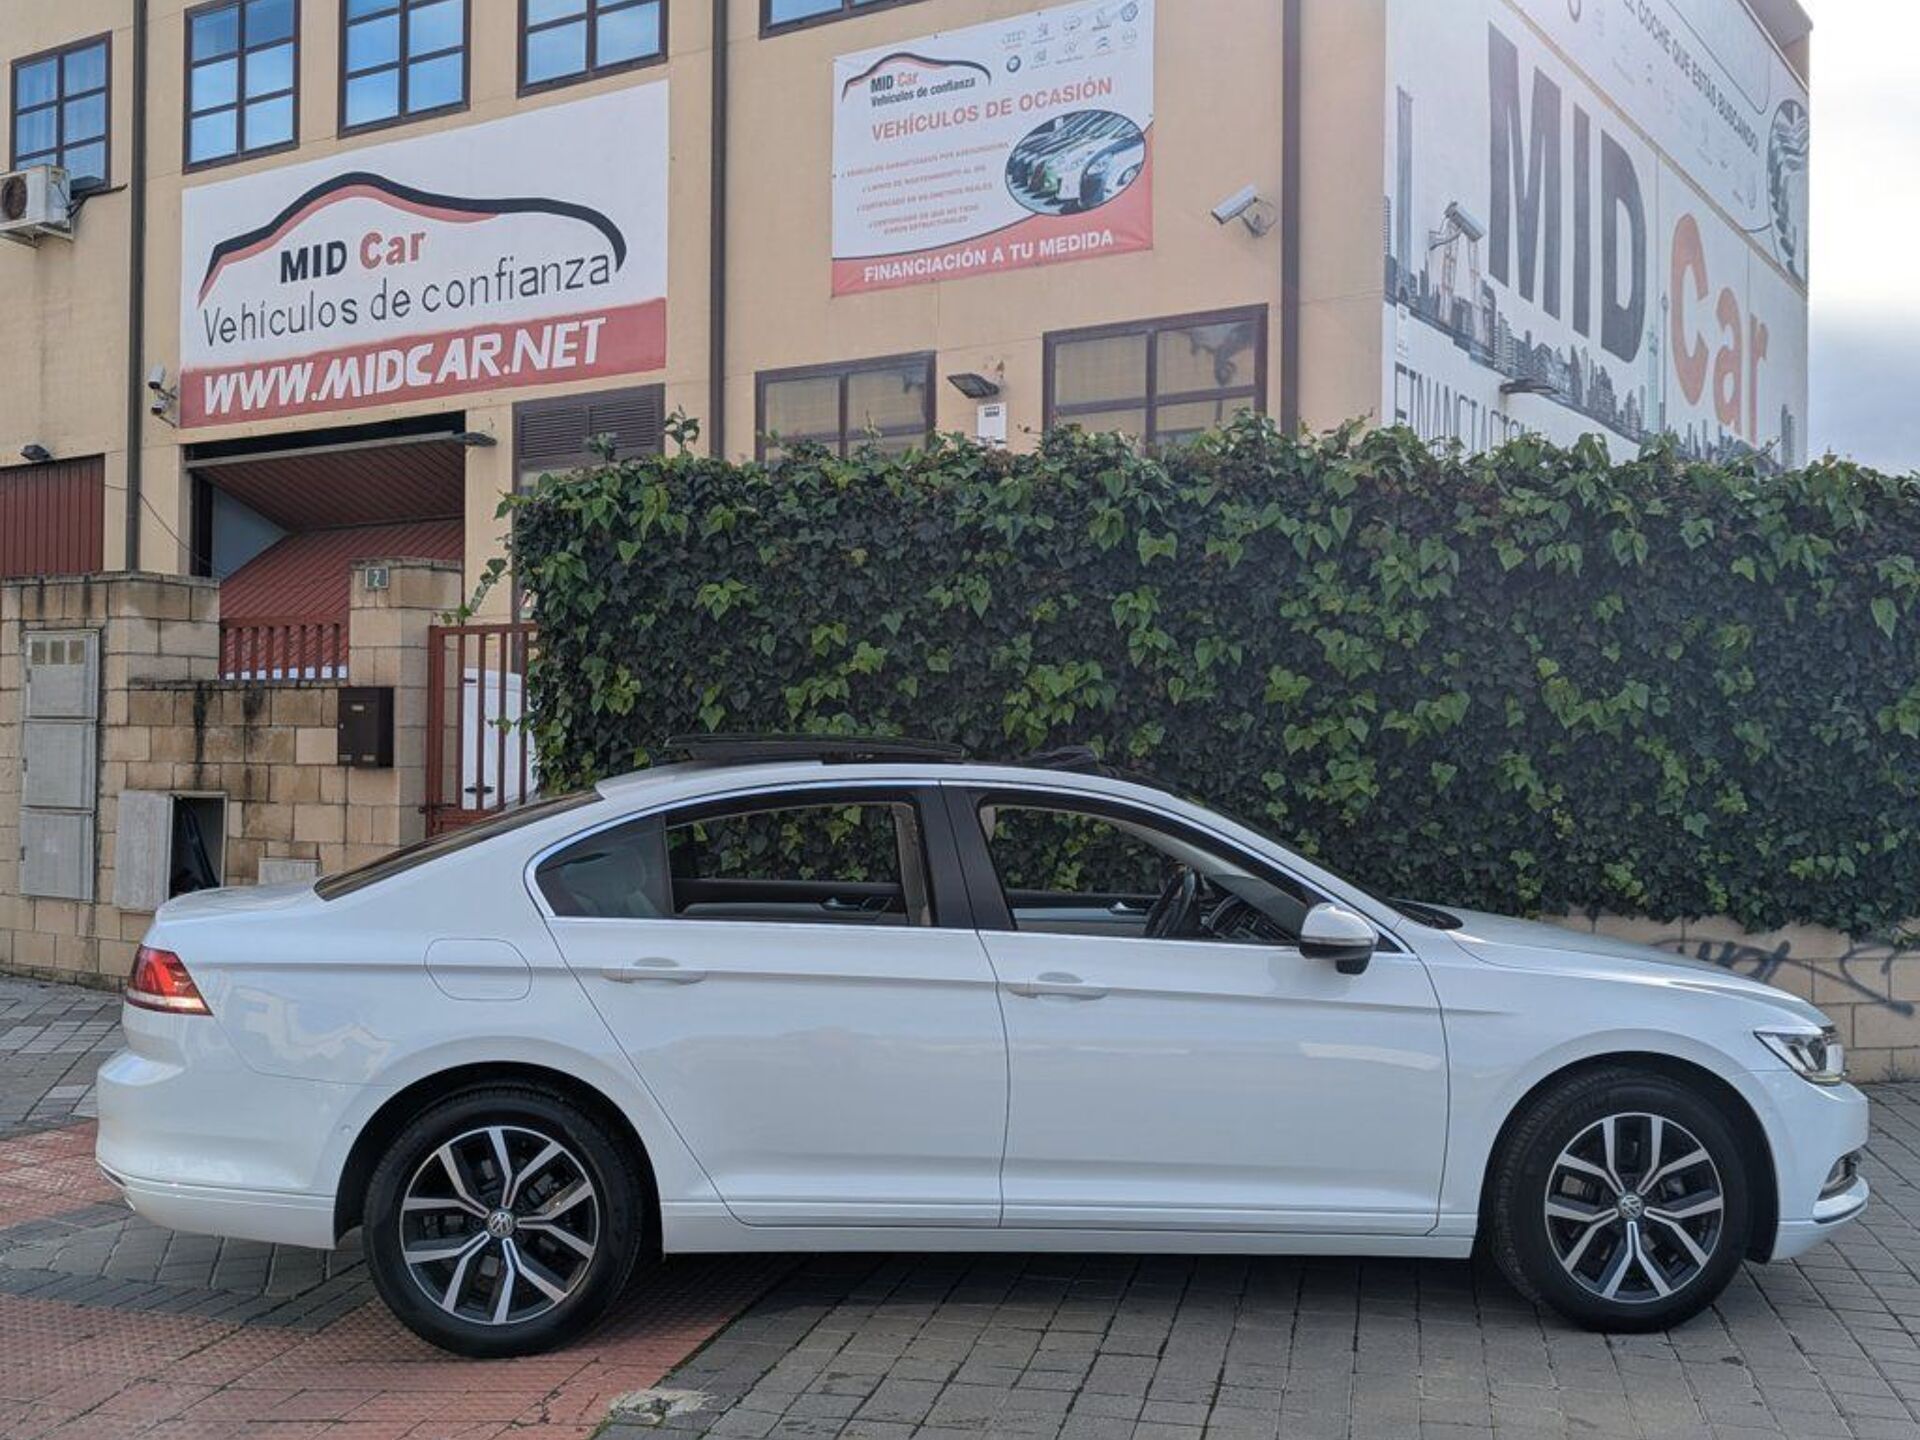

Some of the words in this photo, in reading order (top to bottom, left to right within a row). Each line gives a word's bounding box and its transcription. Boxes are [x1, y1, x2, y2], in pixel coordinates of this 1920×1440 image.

[870, 74, 894, 93] MID
[897, 71, 919, 87] Car
[871, 105, 980, 141] VEHÍCULOS
[985, 100, 1013, 118] DE
[1018, 75, 1113, 110] OCASIÓN
[916, 85, 928, 97] de
[929, 77, 976, 95] confianza
[279, 239, 348, 284] MID
[359, 229, 427, 271] Car
[863, 248, 987, 283] FINANCIACIÓN
[991, 247, 1005, 265] A
[1009, 242, 1034, 261] TU
[1039, 229, 1114, 257] MEDIDA
[1488, 20, 1646, 364] MID
[1670, 213, 1769, 448] Car
[203, 290, 358, 347] Vehículos
[370, 277, 412, 322] de
[421, 255, 610, 313] confianza
[203, 316, 607, 416] WWW.MIDCAR.NET
